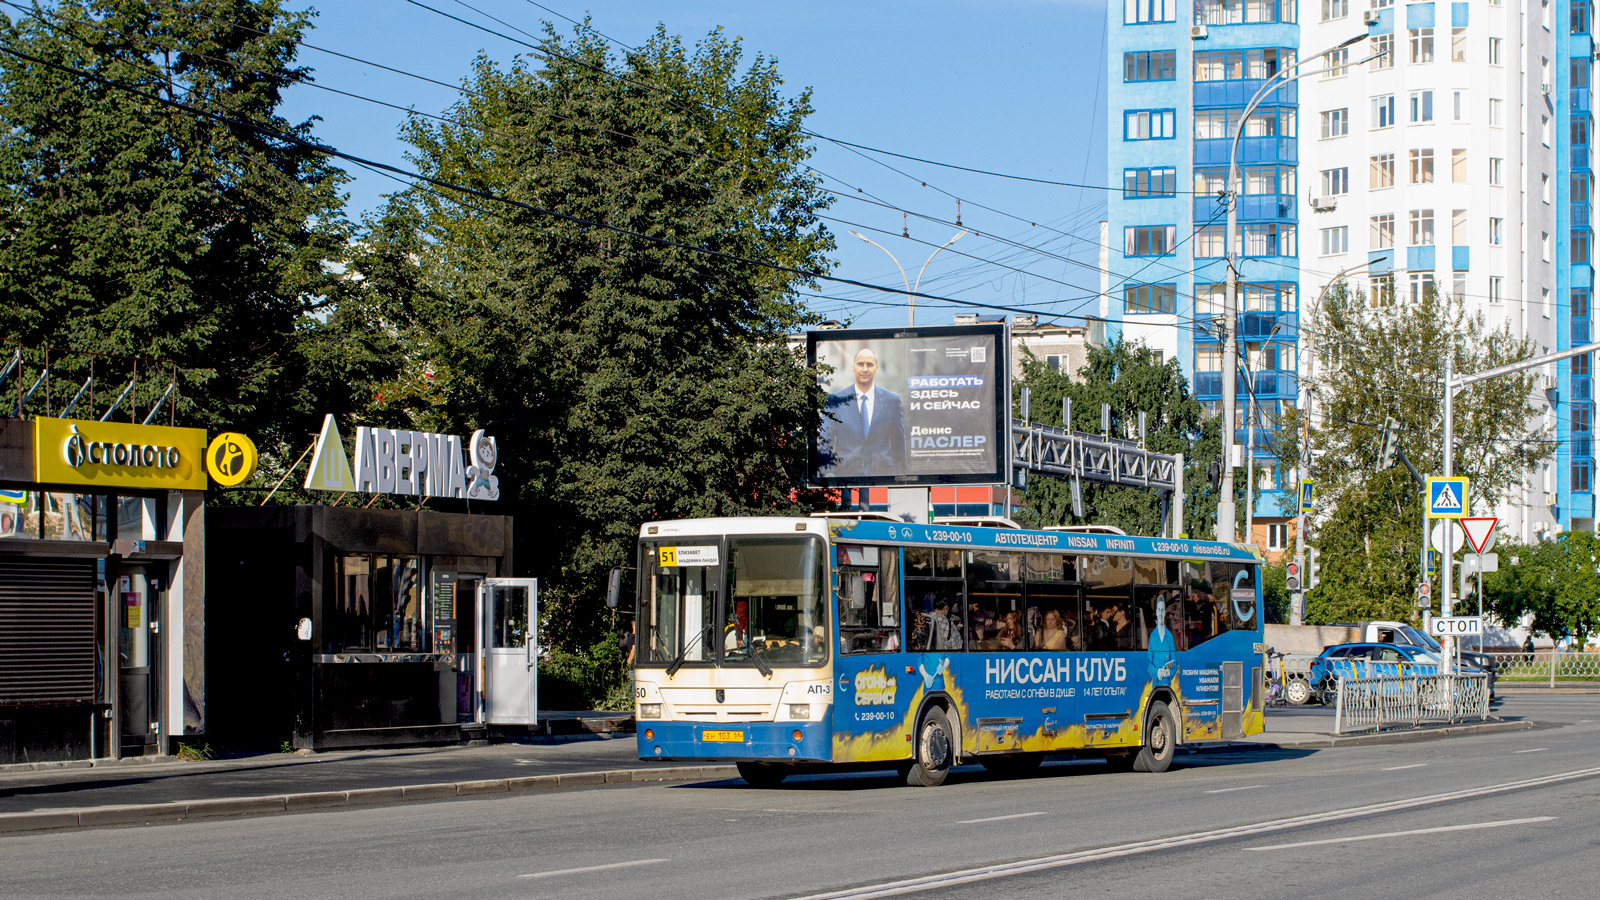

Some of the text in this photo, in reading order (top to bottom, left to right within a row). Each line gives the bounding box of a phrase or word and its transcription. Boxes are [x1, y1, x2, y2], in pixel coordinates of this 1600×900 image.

[910, 377, 984, 387] РАБОТАТЬ
[910, 390, 958, 400] ЗДЕСЬ
[910, 400, 980, 410] И СЕЙЧАС
[910, 426, 952, 436] Денис
[910, 436, 986, 448] ПАСЛЕР
[932, 530, 972, 542] 239-00-10
[995, 533, 1058, 546] АВТОТЕХЦЕНТР
[1068, 536, 1135, 550] NISSAN INFINITI
[1156, 542, 1230, 556] 239-00-10 nissan66.ru
[662, 552, 674, 562] 51
[1436, 620, 1478, 632] СТОП
[986, 658, 1126, 684] НИССАН КЛУБ
[856, 676, 886, 689] ОГОНЬ
[807, 685, 831, 694] АП-3
[986, 687, 1075, 699] РАБОТАЕМ С ОГНЁМ В ДУШЕ!
[1083, 688, 1090, 696] 14
[1091, 688, 1103, 696] ЛЕТ
[856, 692, 895, 705] СЕРВИС!
[861, 712, 895, 720] 239-00-10
